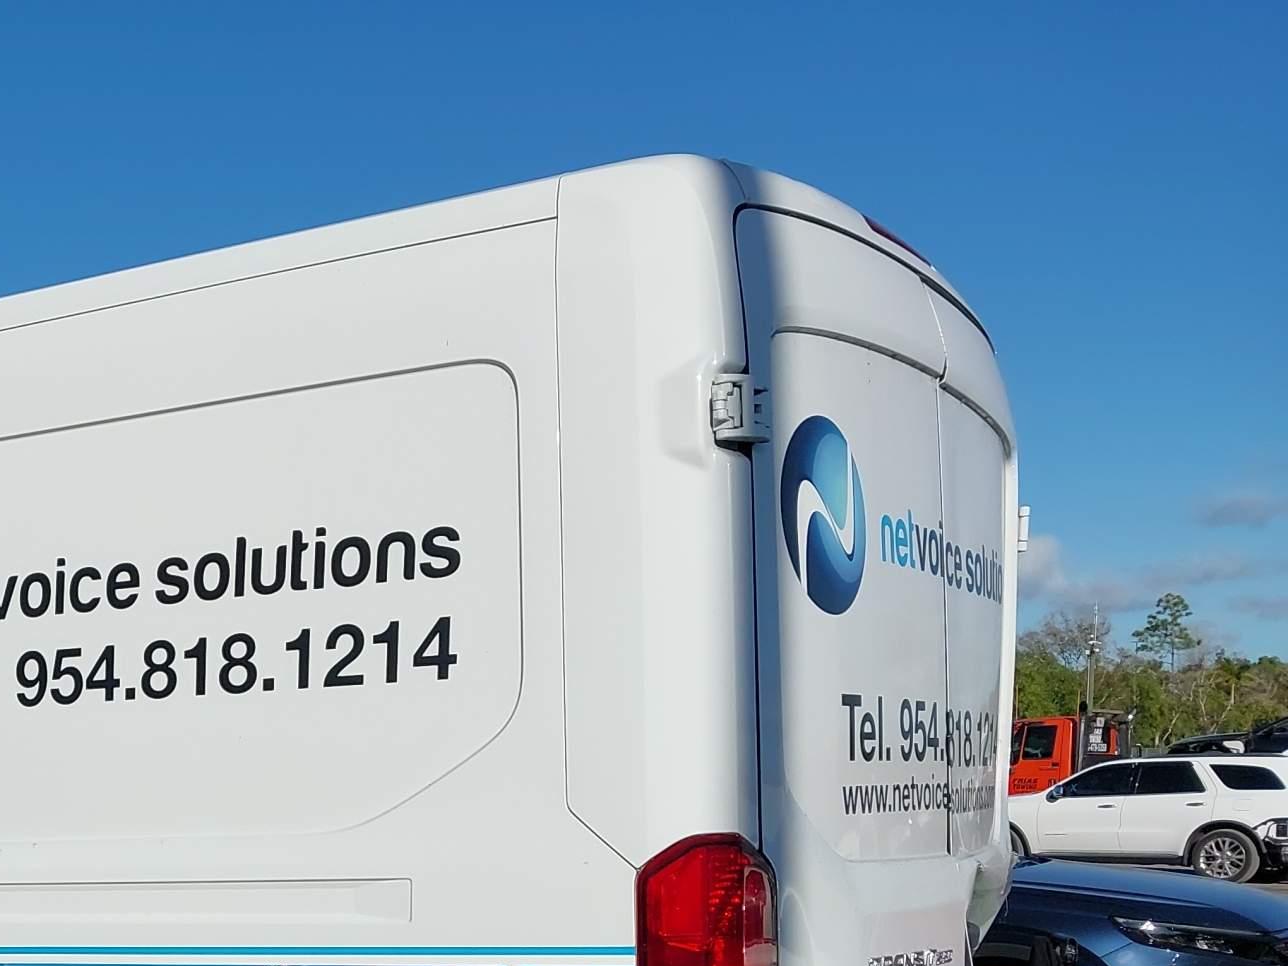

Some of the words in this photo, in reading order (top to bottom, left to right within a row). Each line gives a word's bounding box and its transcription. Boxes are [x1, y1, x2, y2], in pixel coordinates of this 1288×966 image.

[154, 526, 461, 605] solutions
[880, 508, 963, 590] netvoice
[15, 615, 458, 708] 954.818.1214
[841, 693, 892, 762] Tel.
